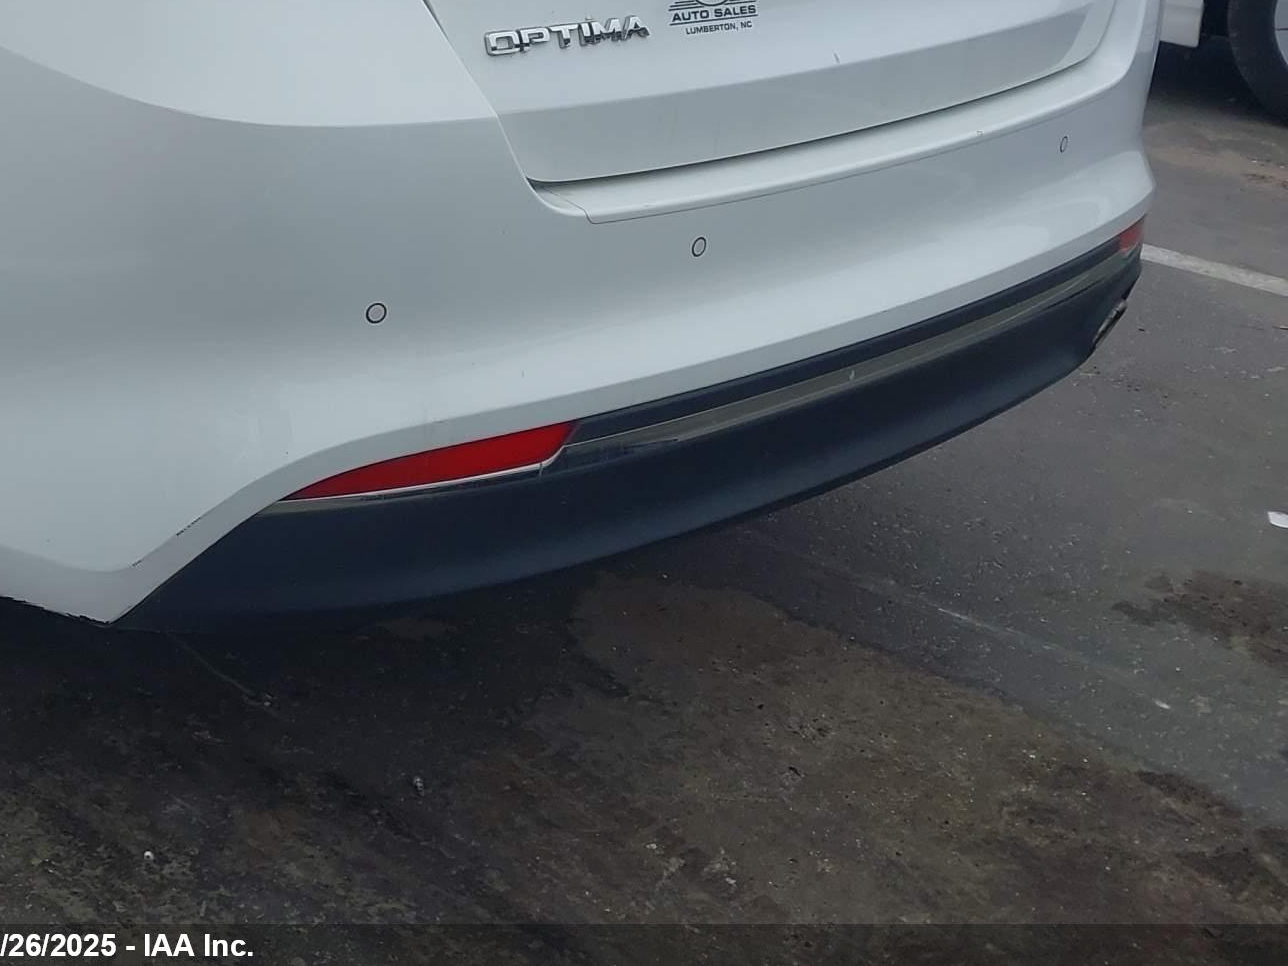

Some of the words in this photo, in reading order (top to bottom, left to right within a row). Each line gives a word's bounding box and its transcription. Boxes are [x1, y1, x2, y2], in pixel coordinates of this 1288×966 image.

[672, 9, 710, 23] AUTO
[714, 4, 757, 18] SALES
[484, 15, 651, 57] OPTIMA
[685, 22, 739, 35] LUMBERTON,
[740, 20, 753, 29] NC
